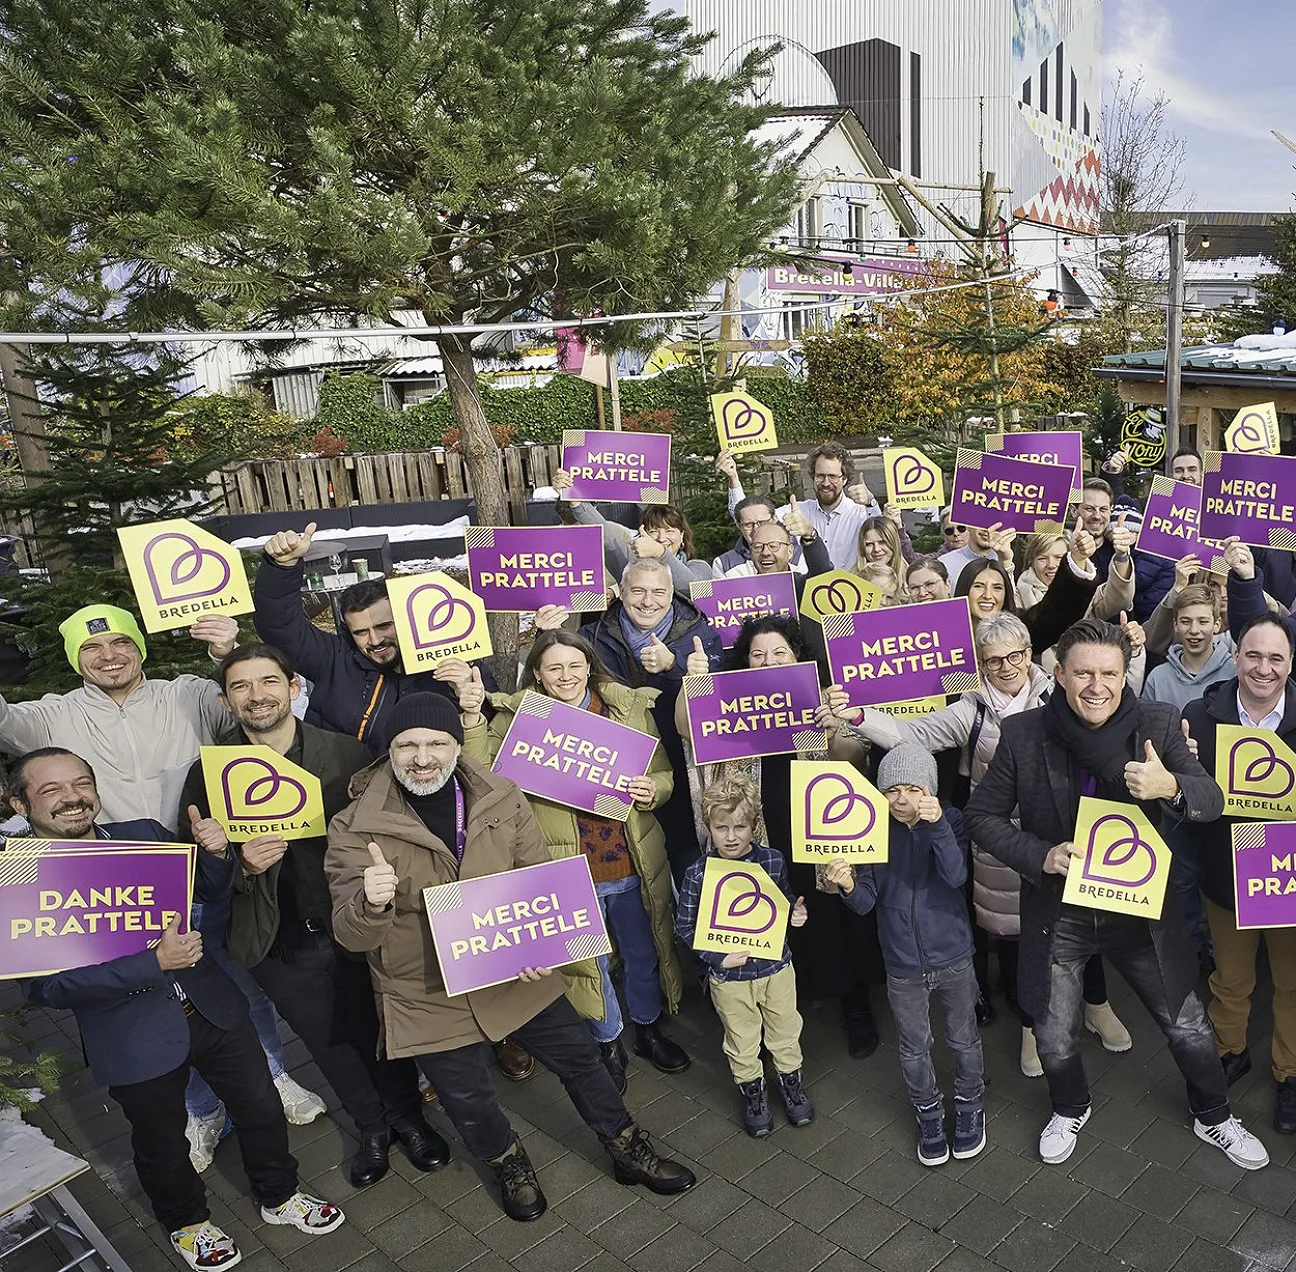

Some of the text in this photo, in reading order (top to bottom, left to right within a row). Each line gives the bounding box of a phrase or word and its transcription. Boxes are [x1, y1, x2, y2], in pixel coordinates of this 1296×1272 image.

[727, 437, 769, 449] BREDELLA
[587, 452, 645, 467] MERCI
[569, 466, 661, 483] PRATTELE
[982, 477, 1045, 499] MERCI
[1221, 479, 1277, 498] MERCI
[896, 495, 937, 504] BREDELLA
[961, 490, 1060, 515] PRATTELE
[1206, 497, 1295, 524] PRATTELE
[500, 552, 573, 569] MERCI
[481, 570, 595, 589] PRATTELE
[159, 596, 239, 619] BREDELLA
[717, 594, 772, 613] MERCI
[417, 641, 481, 662] BREDELLA
[861, 631, 940, 658] MERCI
[842, 648, 966, 683] PRATTELE
[720, 692, 792, 715] MERCI
[701, 708, 815, 738] PRATTELE
[542, 728, 618, 766] MERCI
[512, 740, 631, 793] PRATTELE
[1228, 798, 1293, 814] BREDELLA
[229, 820, 311, 835] BREDELLA
[806, 844, 875, 856] BREDELLA
[39, 886, 155, 911] DANKE
[1079, 884, 1150, 906] BREDELLA
[472, 893, 560, 931] MERCI
[451, 908, 591, 961] PRATTELE
[707, 932, 771, 949] BREDELLA
